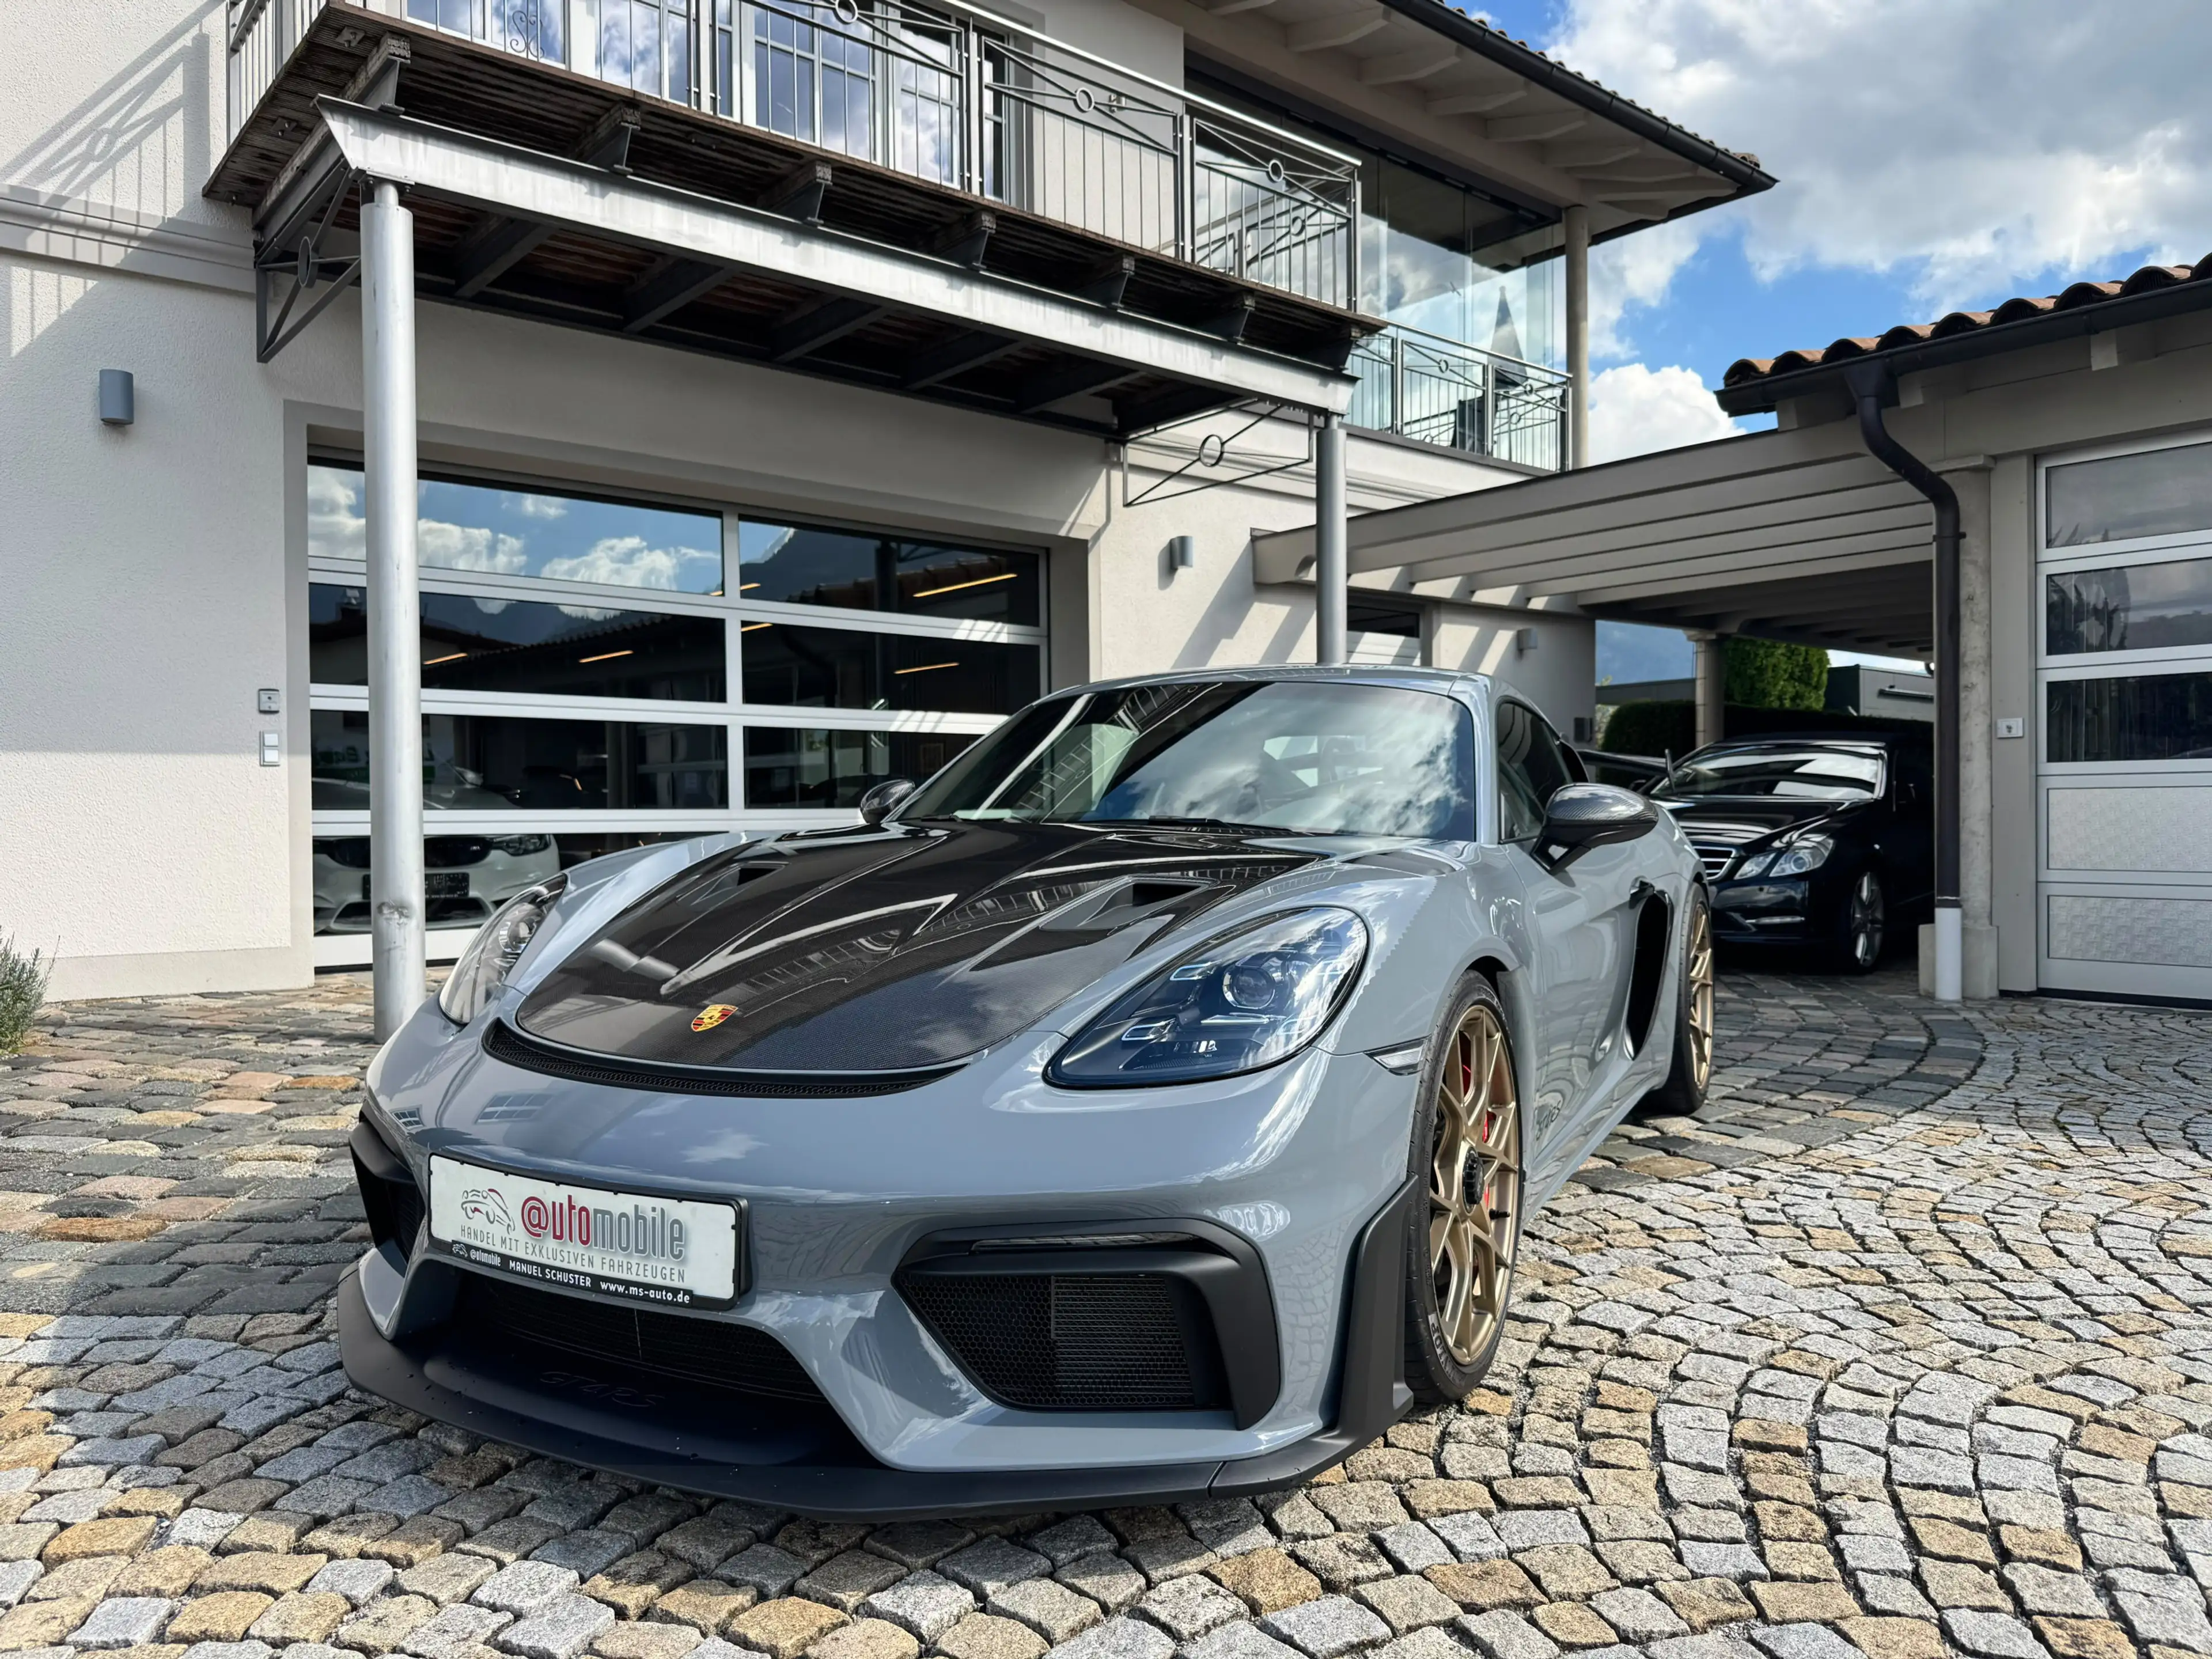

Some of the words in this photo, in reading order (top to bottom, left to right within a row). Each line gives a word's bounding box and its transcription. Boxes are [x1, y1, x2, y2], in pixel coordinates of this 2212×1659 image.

[461, 1225, 496, 1246] HANDEL
[501, 1236, 520, 1252] MIT
[525, 1241, 594, 1268] EXKLUSIVEN
[601, 1257, 684, 1283] FAHRZEUGEN
[521, 1194, 684, 1261] @utomobile
[509, 1260, 543, 1277] MANUEL
[545, 1268, 591, 1287] SCHUSTER
[600, 1281, 690, 1304] www.ms-auto.de
